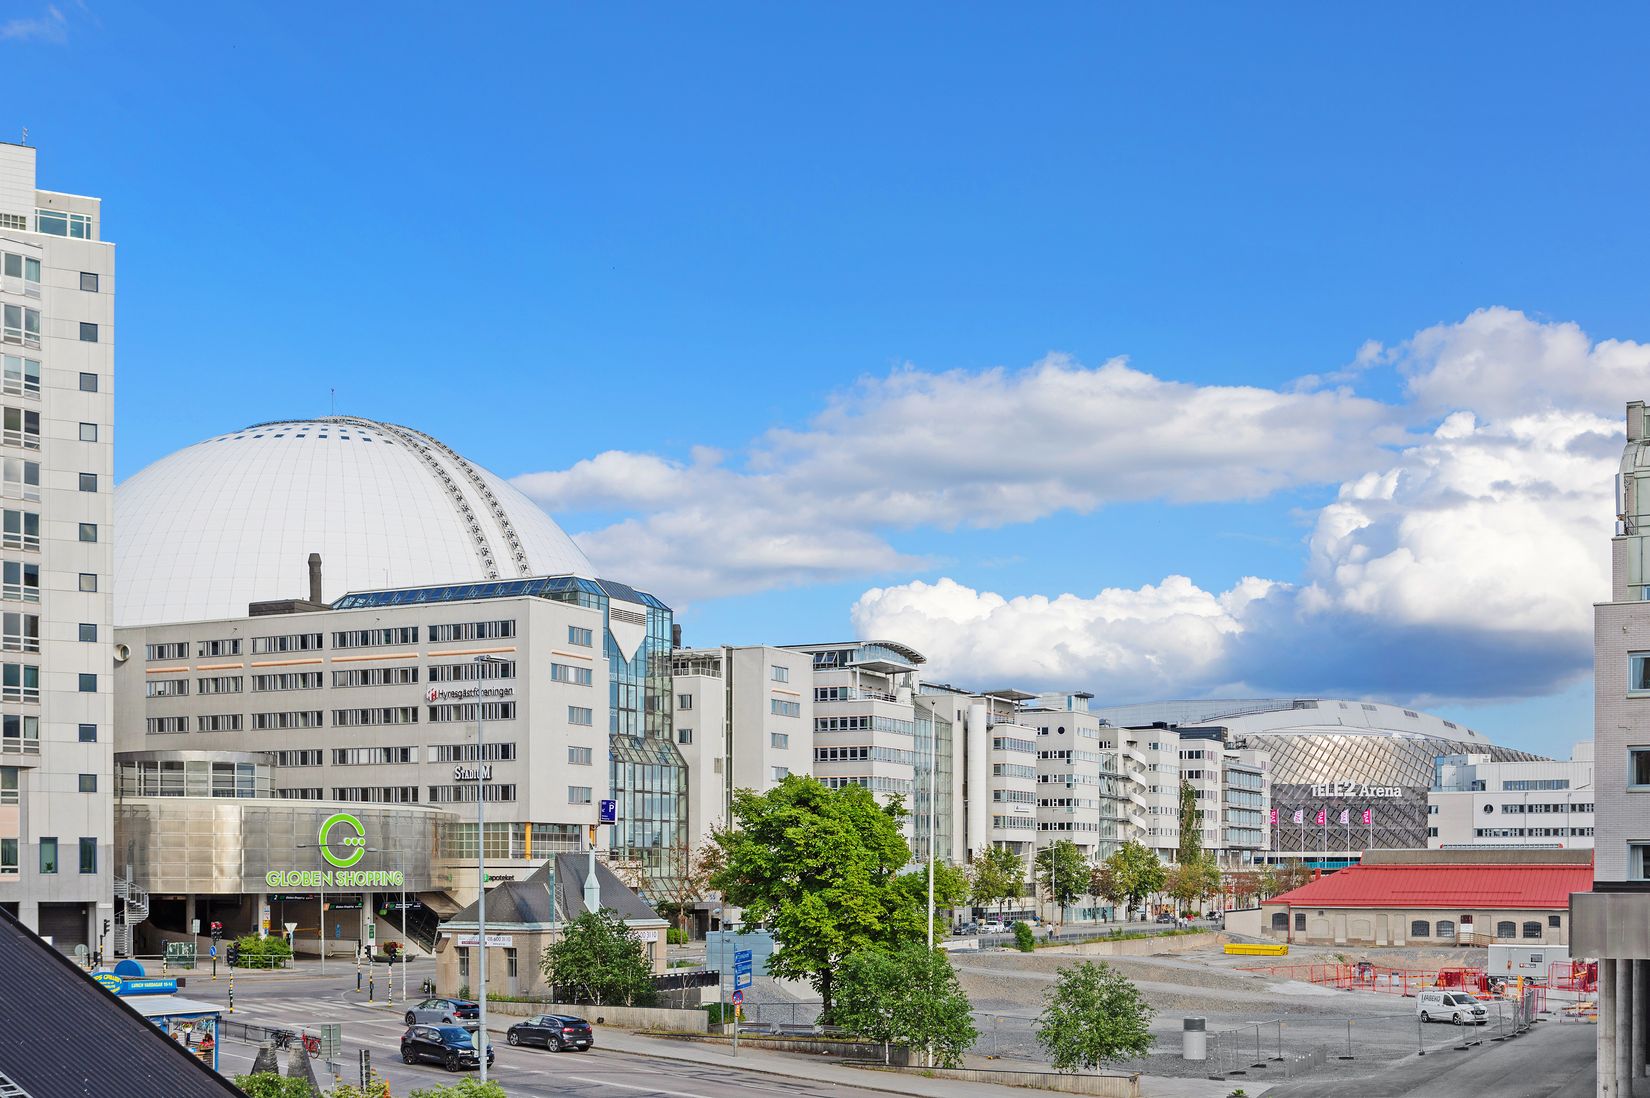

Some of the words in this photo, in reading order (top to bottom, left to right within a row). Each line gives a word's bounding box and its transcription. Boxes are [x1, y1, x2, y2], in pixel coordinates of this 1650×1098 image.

[1311, 779, 1357, 797] TELE2
[1358, 784, 1403, 797] Arena
[266, 870, 333, 887] GLOBEN
[335, 870, 404, 887] SHOPPING
